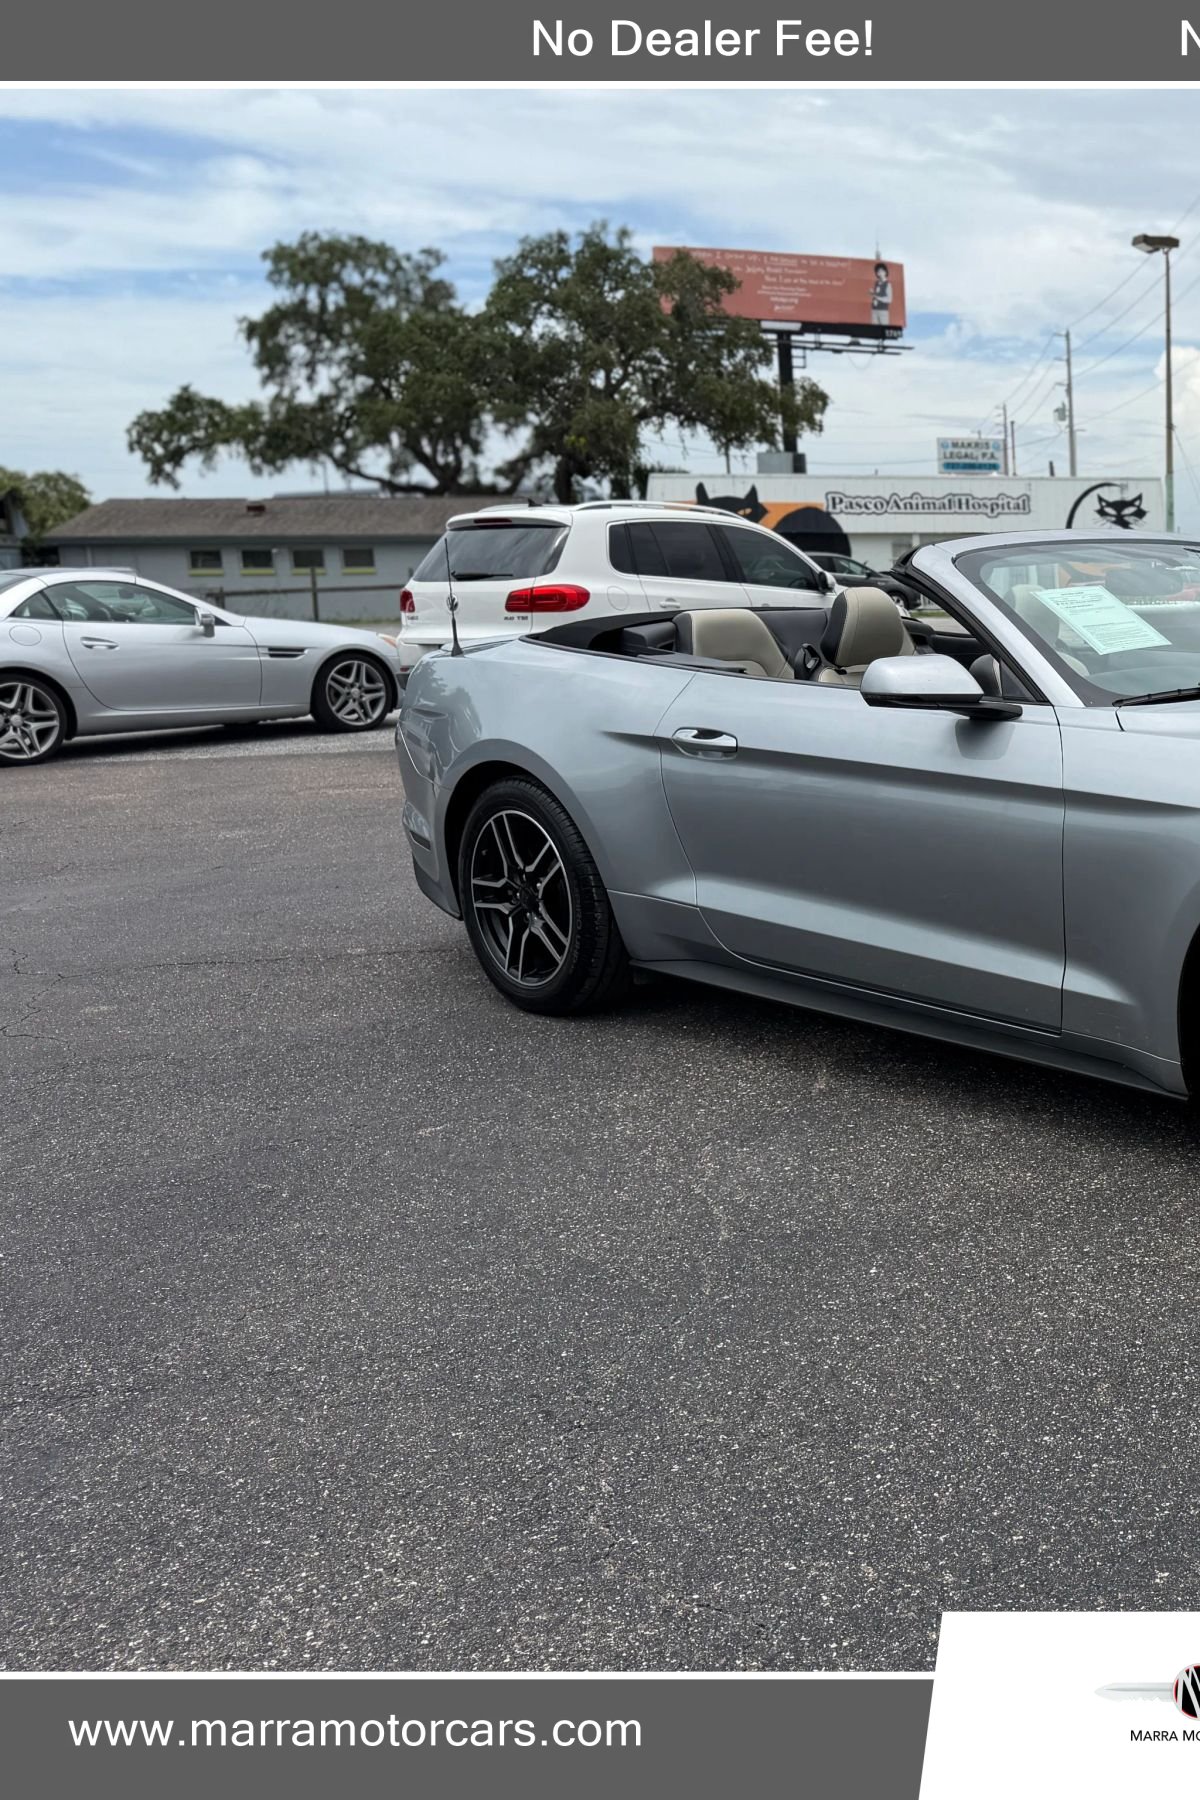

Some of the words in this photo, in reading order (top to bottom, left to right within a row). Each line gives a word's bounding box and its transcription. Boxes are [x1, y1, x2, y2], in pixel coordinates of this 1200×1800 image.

[830, 495, 886, 512] Pasco
[887, 494, 951, 512] Animal
[955, 494, 1029, 516] Hospital
